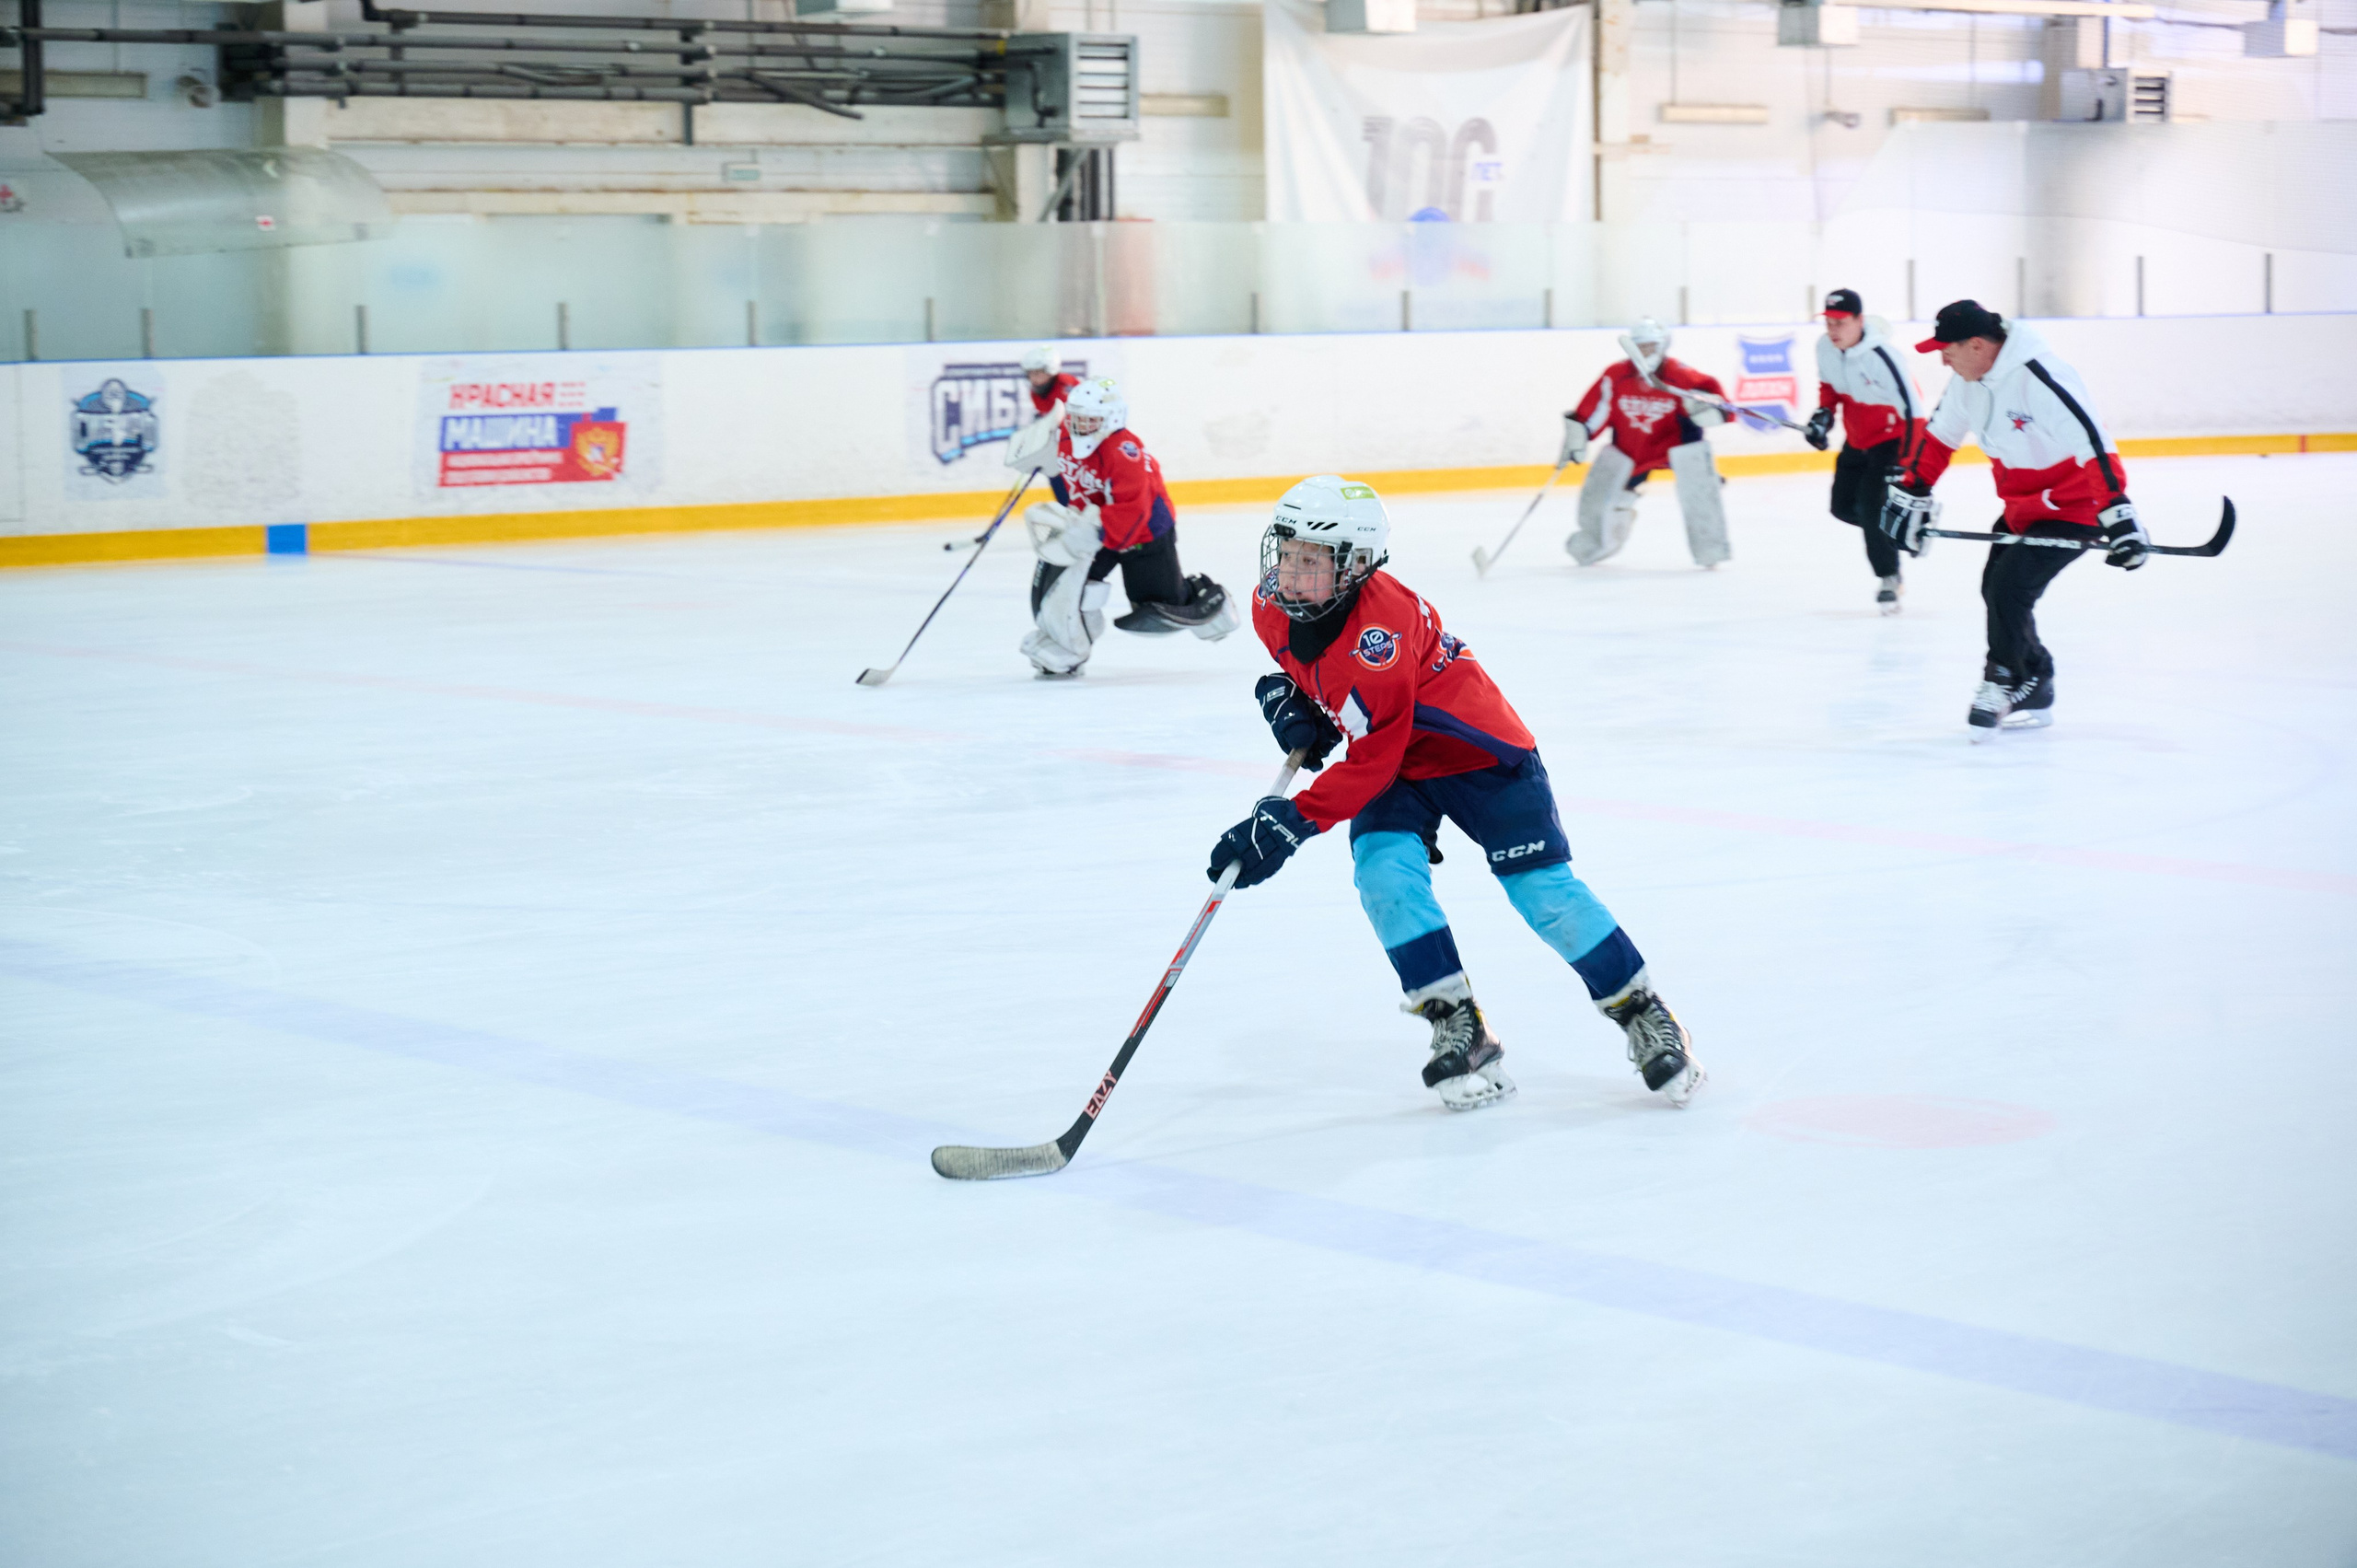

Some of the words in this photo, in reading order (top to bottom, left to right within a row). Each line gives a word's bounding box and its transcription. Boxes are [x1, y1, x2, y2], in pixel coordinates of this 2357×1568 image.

[446, 415, 558, 449] МАШИНА
[1275, 515, 1297, 525] CCM
[1363, 631, 1385, 647] 10
[1363, 640, 1394, 657] STEPS
[1492, 840, 1546, 863] CCM
[1083, 1069, 1119, 1121] EAZY
